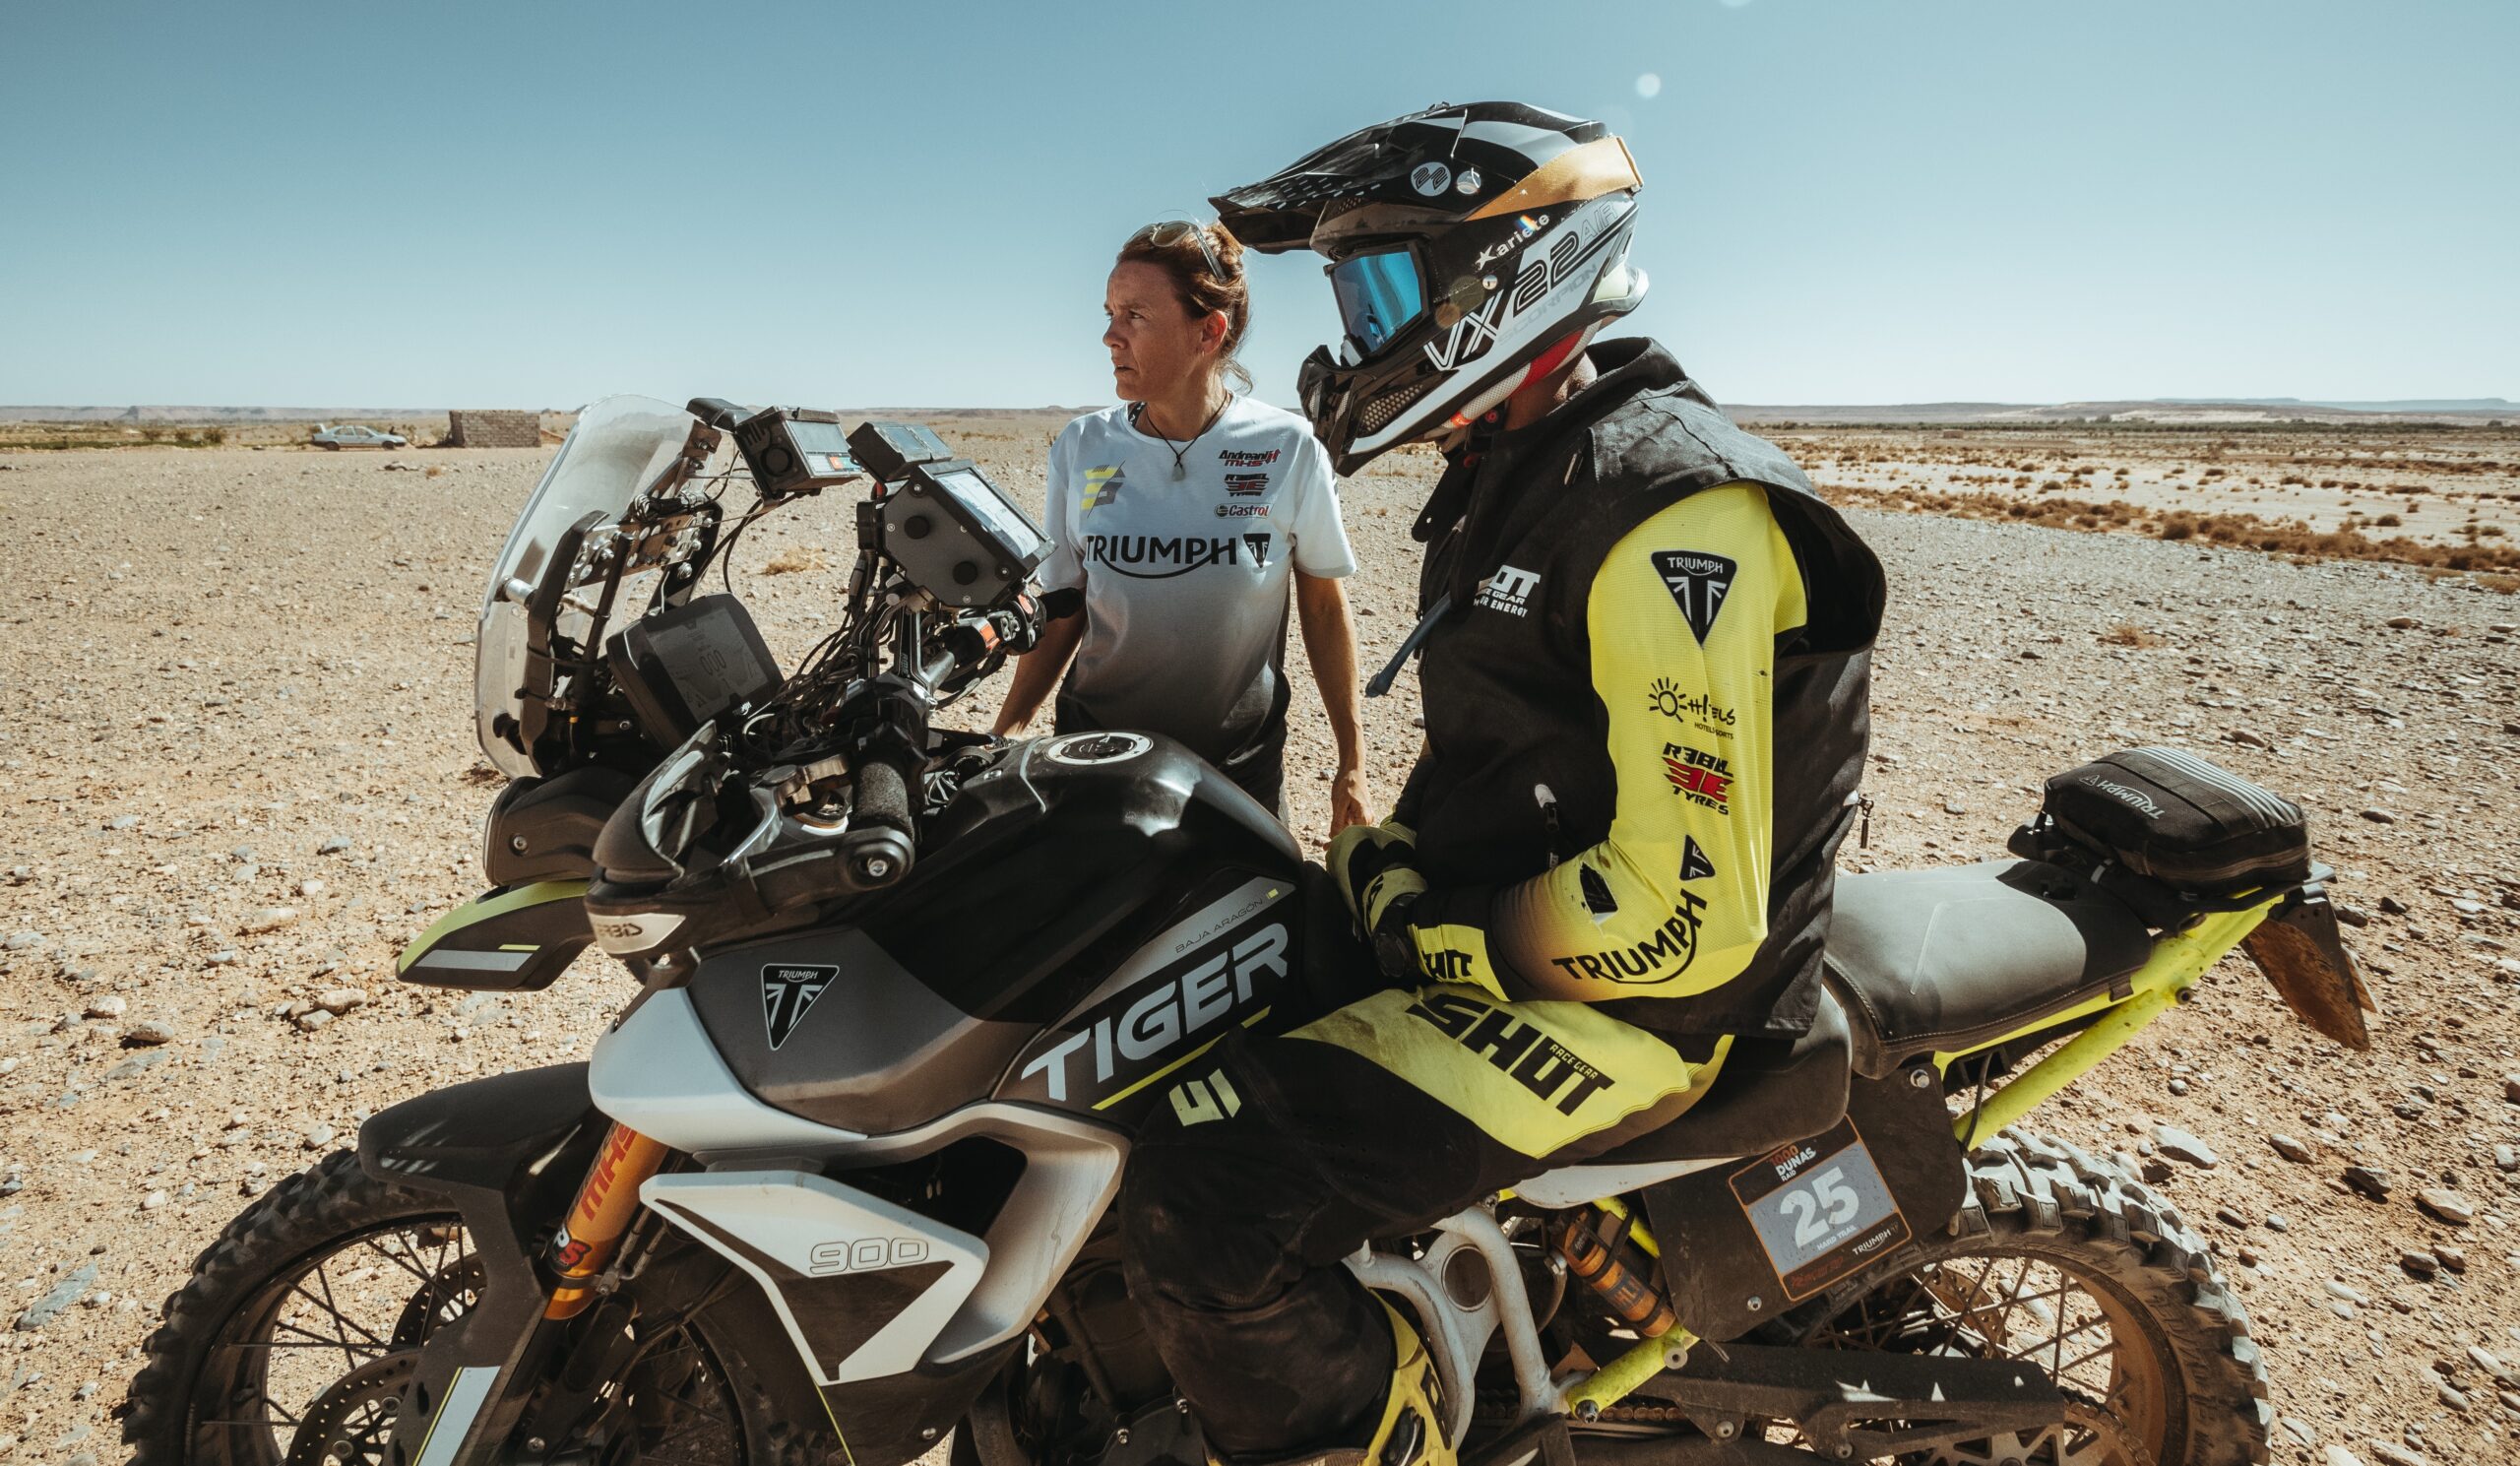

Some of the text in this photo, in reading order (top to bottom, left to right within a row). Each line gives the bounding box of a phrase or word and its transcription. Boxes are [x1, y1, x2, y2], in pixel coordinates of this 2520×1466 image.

[1498, 264, 1599, 343] SCORPION
[1228, 505, 1270, 517] Castrol
[1087, 535, 1237, 579] TRIUMPH
[1667, 556, 1724, 575] TRIUMPH
[1489, 599, 1528, 618] ENERGY
[1492, 591, 1526, 606] GEAR
[1672, 785, 1730, 815] TYRES
[2098, 779, 2166, 820] TRIUMPH
[1175, 929, 1211, 954] BAJA
[1551, 888, 1708, 985] TRIUMPH
[778, 969, 818, 983] TRIUMPH
[1021, 923, 1289, 1102] TIGER
[1405, 993, 1616, 1116] SHOT
[1548, 1044, 1599, 1080] RACE GEAR
[1775, 1147, 1817, 1177] DUNAS
[1781, 1170, 1796, 1182] RAID
[1780, 1166, 1859, 1248] 25
[809, 1237, 929, 1275] 900
[1816, 1236, 1837, 1250] HARD
[1852, 1229, 1892, 1256] TRIUMPH
